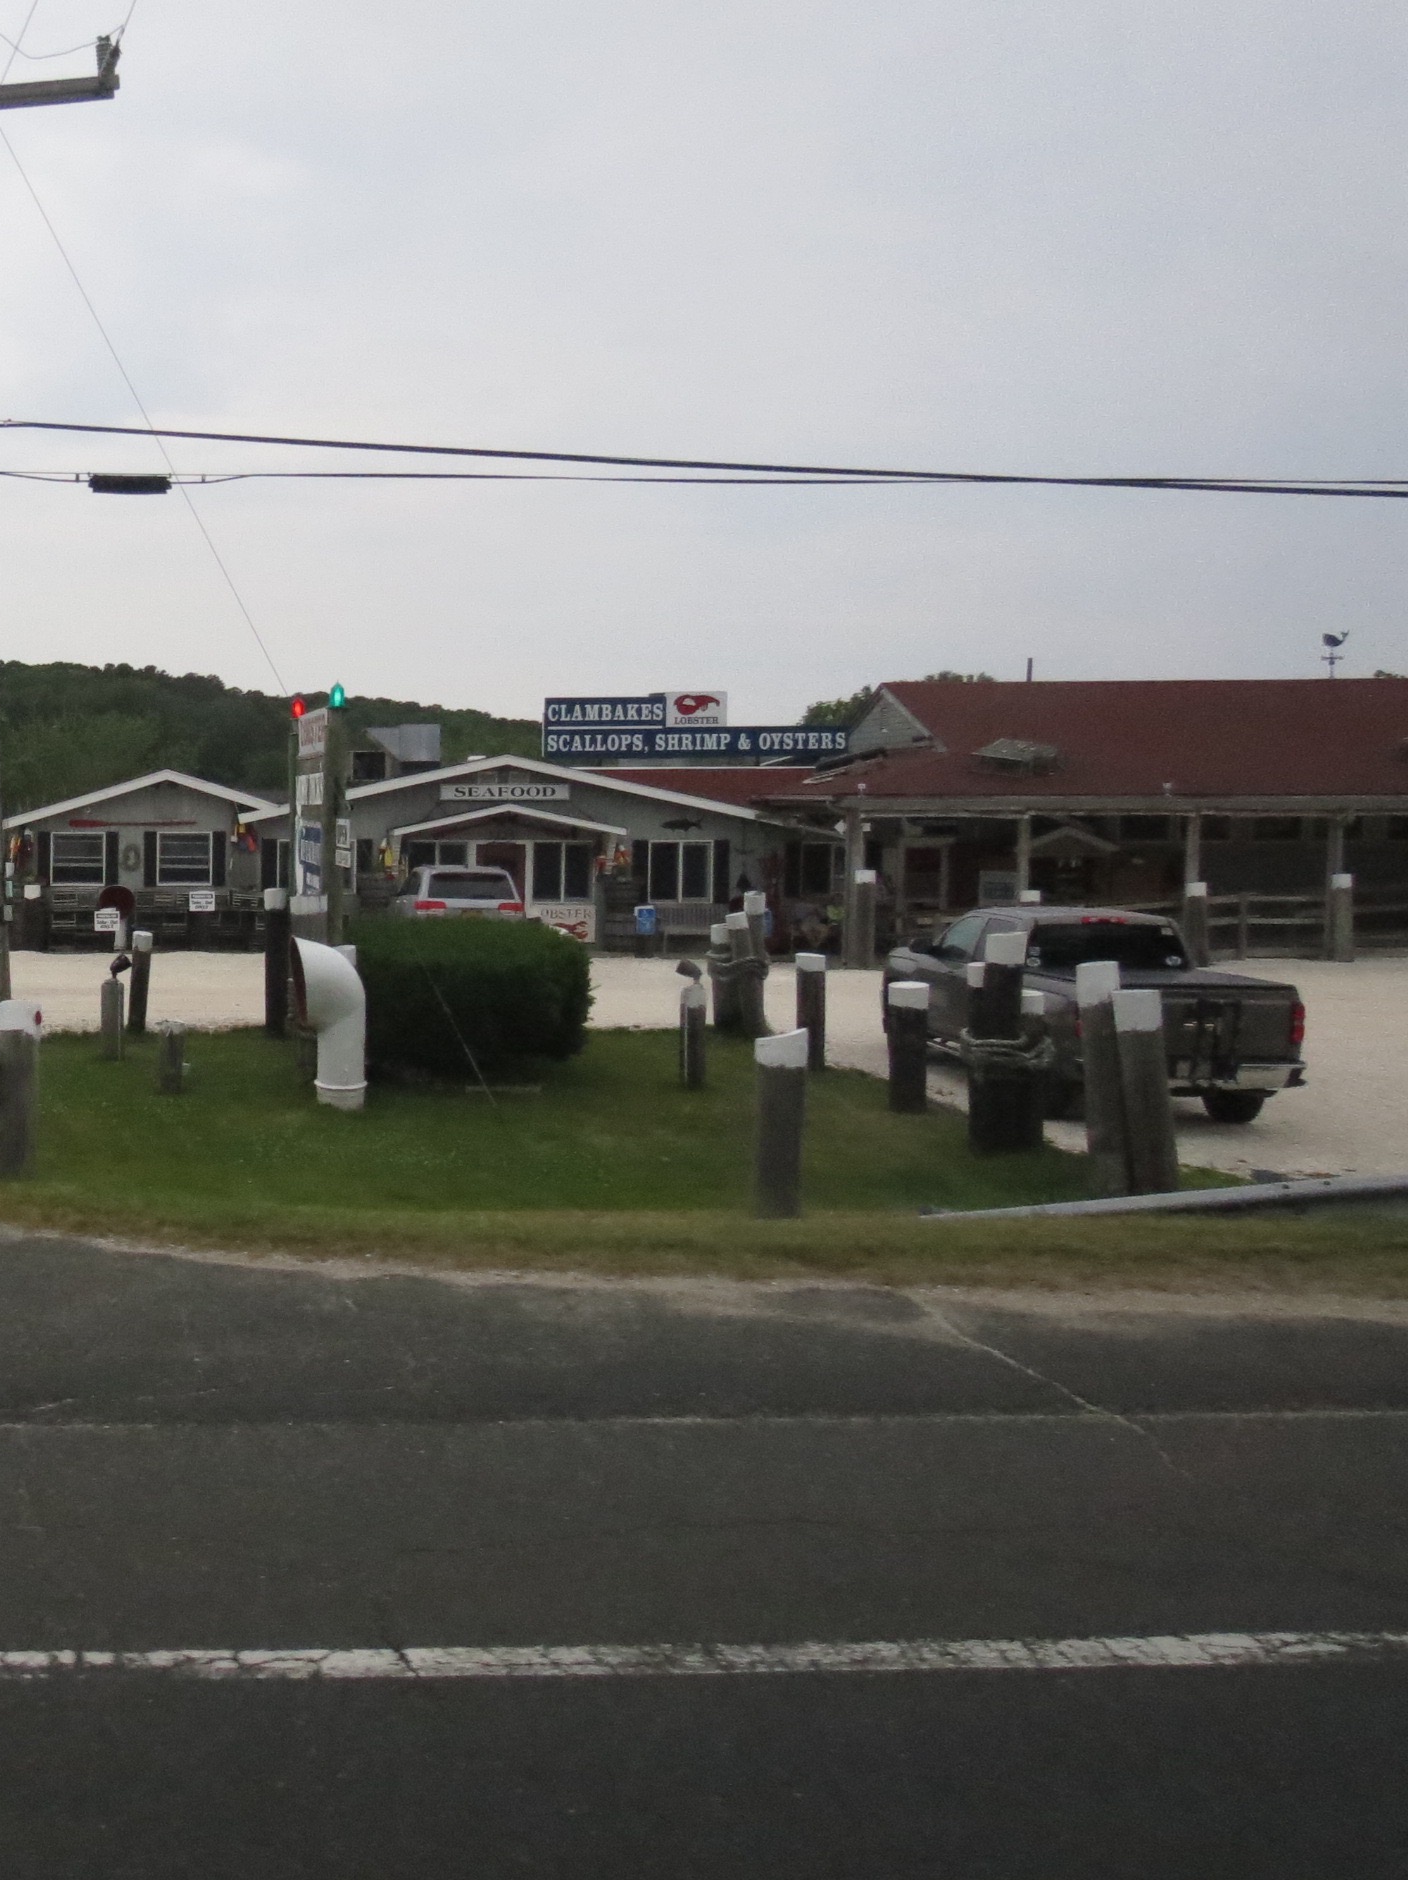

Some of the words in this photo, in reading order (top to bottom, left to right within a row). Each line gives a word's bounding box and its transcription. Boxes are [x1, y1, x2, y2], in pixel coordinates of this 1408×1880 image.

[547, 703, 664, 722] CLAMBAKES
[674, 716, 719, 725] LOBSTER
[547, 734, 649, 753] SCALLOPS,
[655, 733, 731, 751] SHRIMP
[738, 732, 751, 750] &
[758, 731, 847, 750] OYSTERS
[453, 786, 557, 798] SEAFOOD
[540, 908, 592, 920] OBSTER
